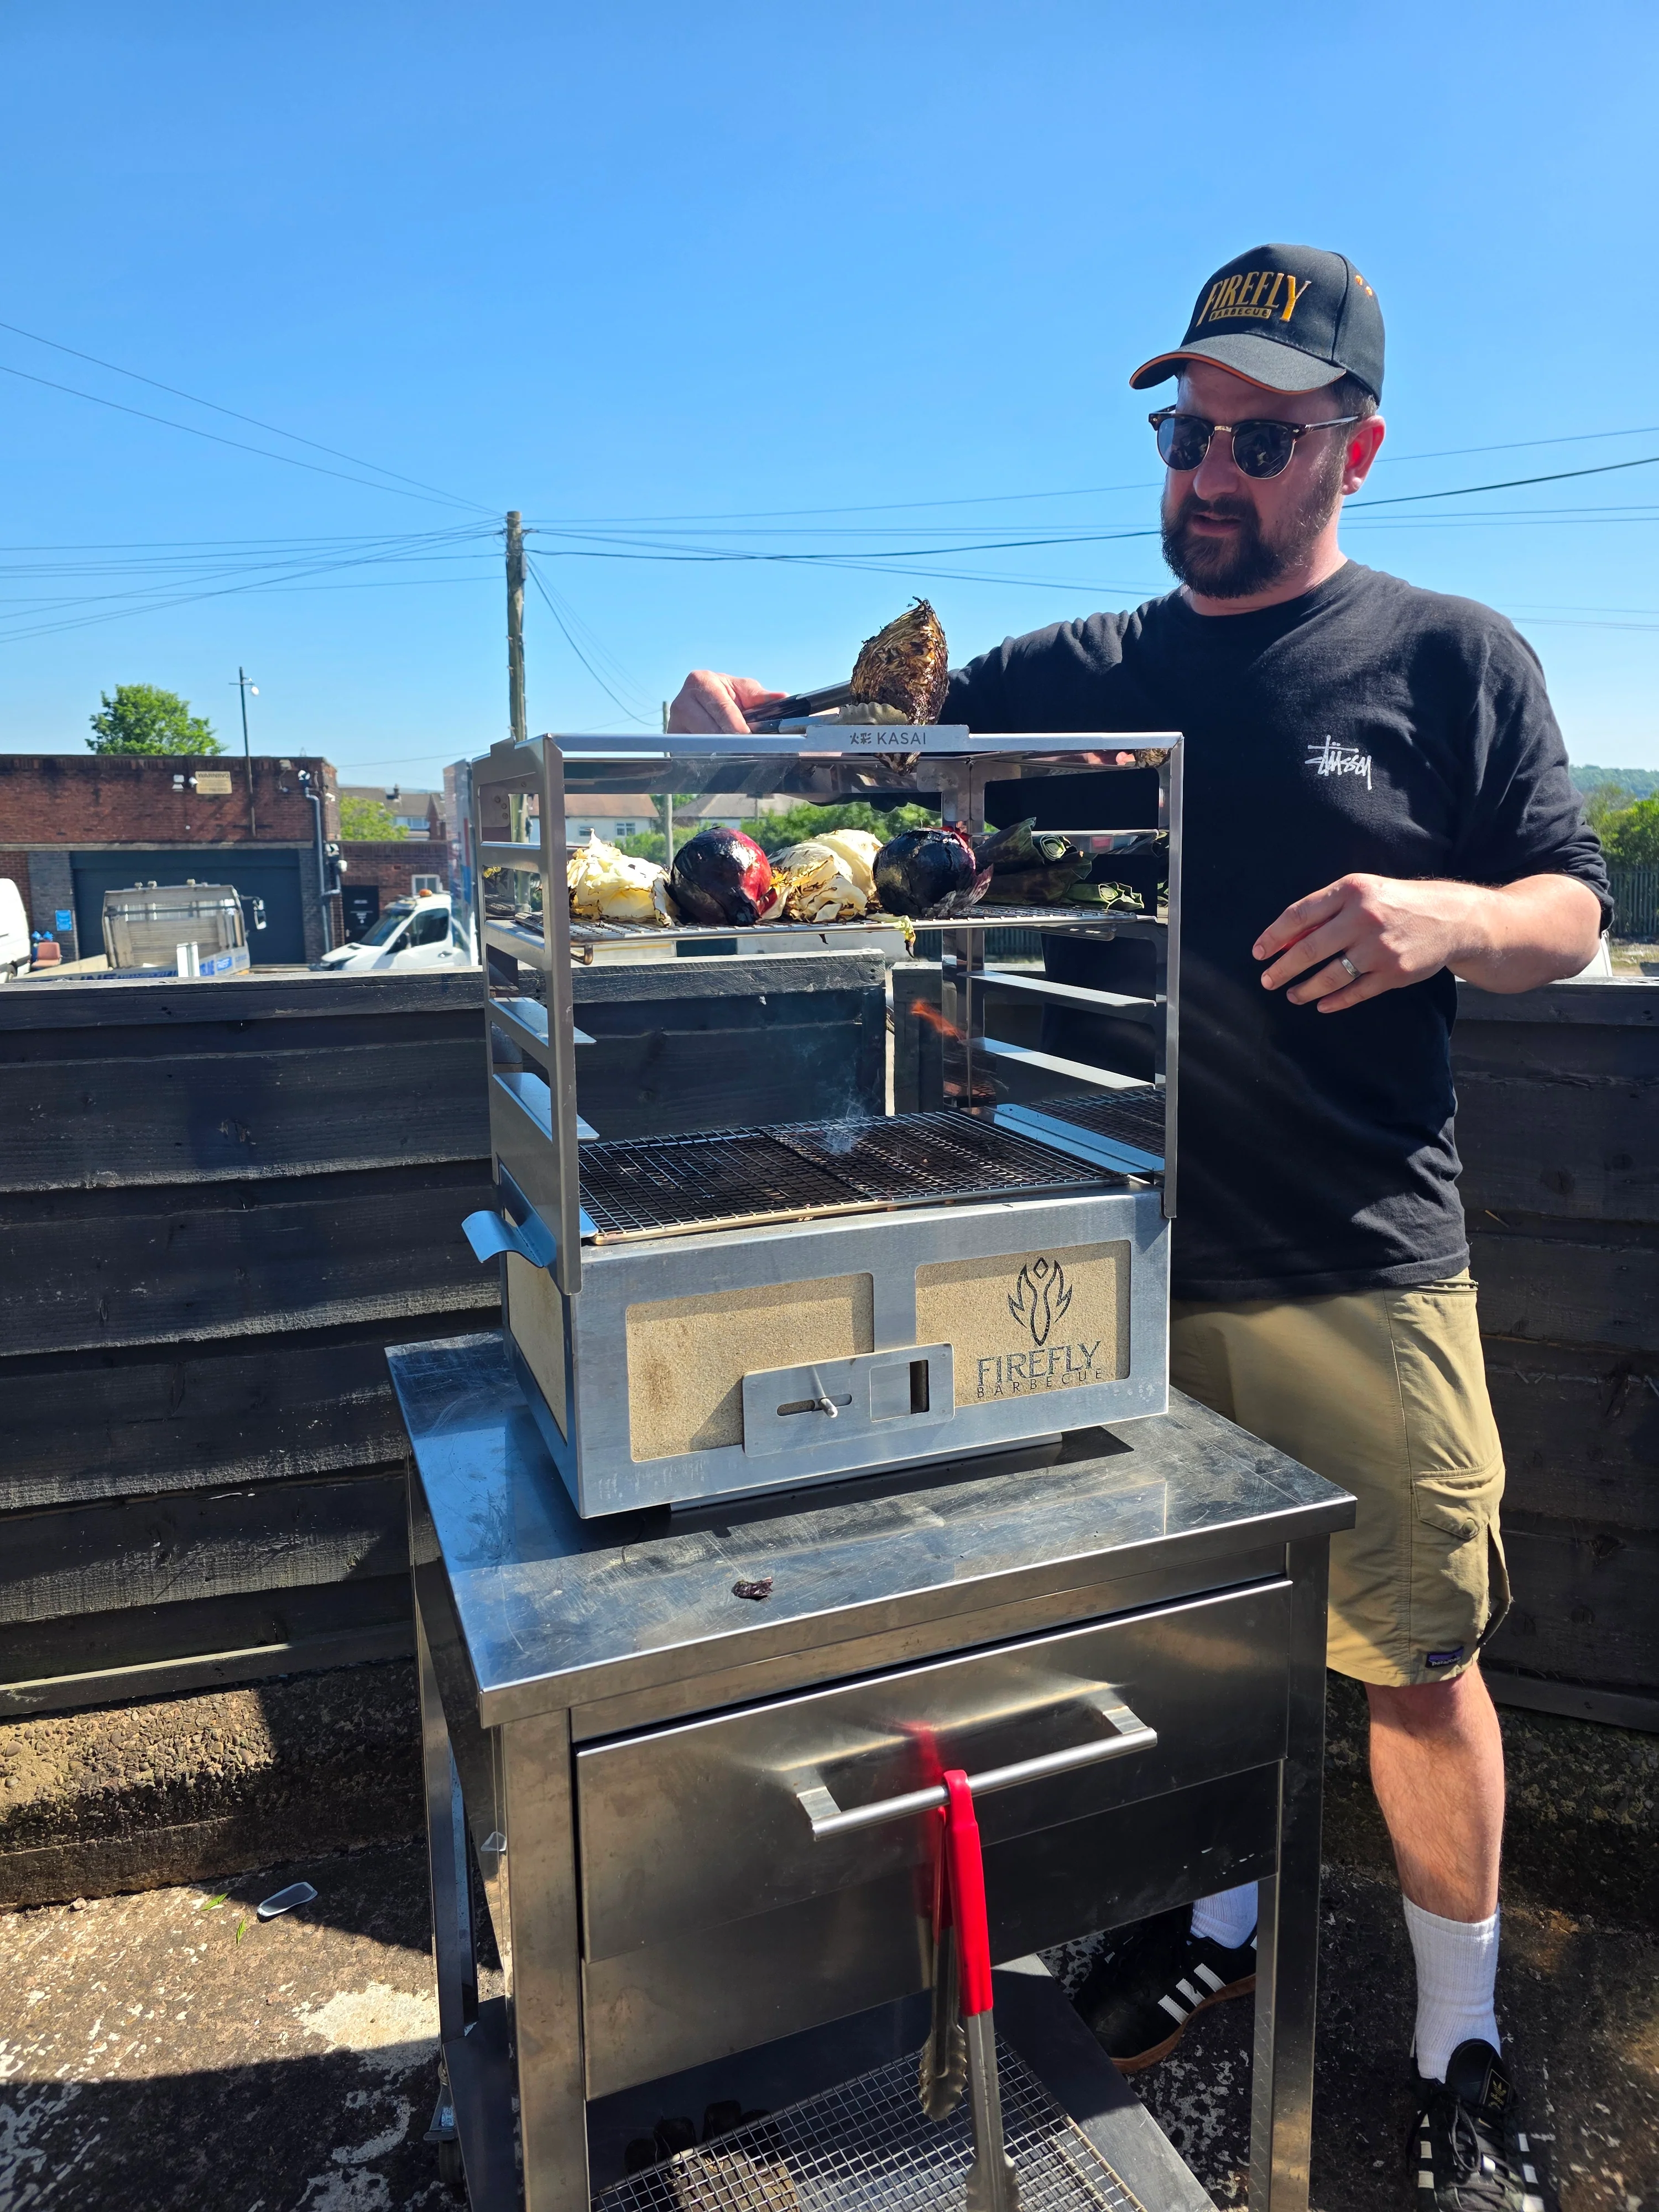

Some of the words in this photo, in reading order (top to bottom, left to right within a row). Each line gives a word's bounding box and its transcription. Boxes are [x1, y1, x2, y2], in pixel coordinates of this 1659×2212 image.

[1196, 272, 1312, 327] FIREFLY
[1211, 308, 1267, 320] BARBECUE
[877, 732, 926, 745] KASAI
[976, 1340, 1102, 1387] FIREFLY
[977, 1368, 1102, 1399] BARBECUE
